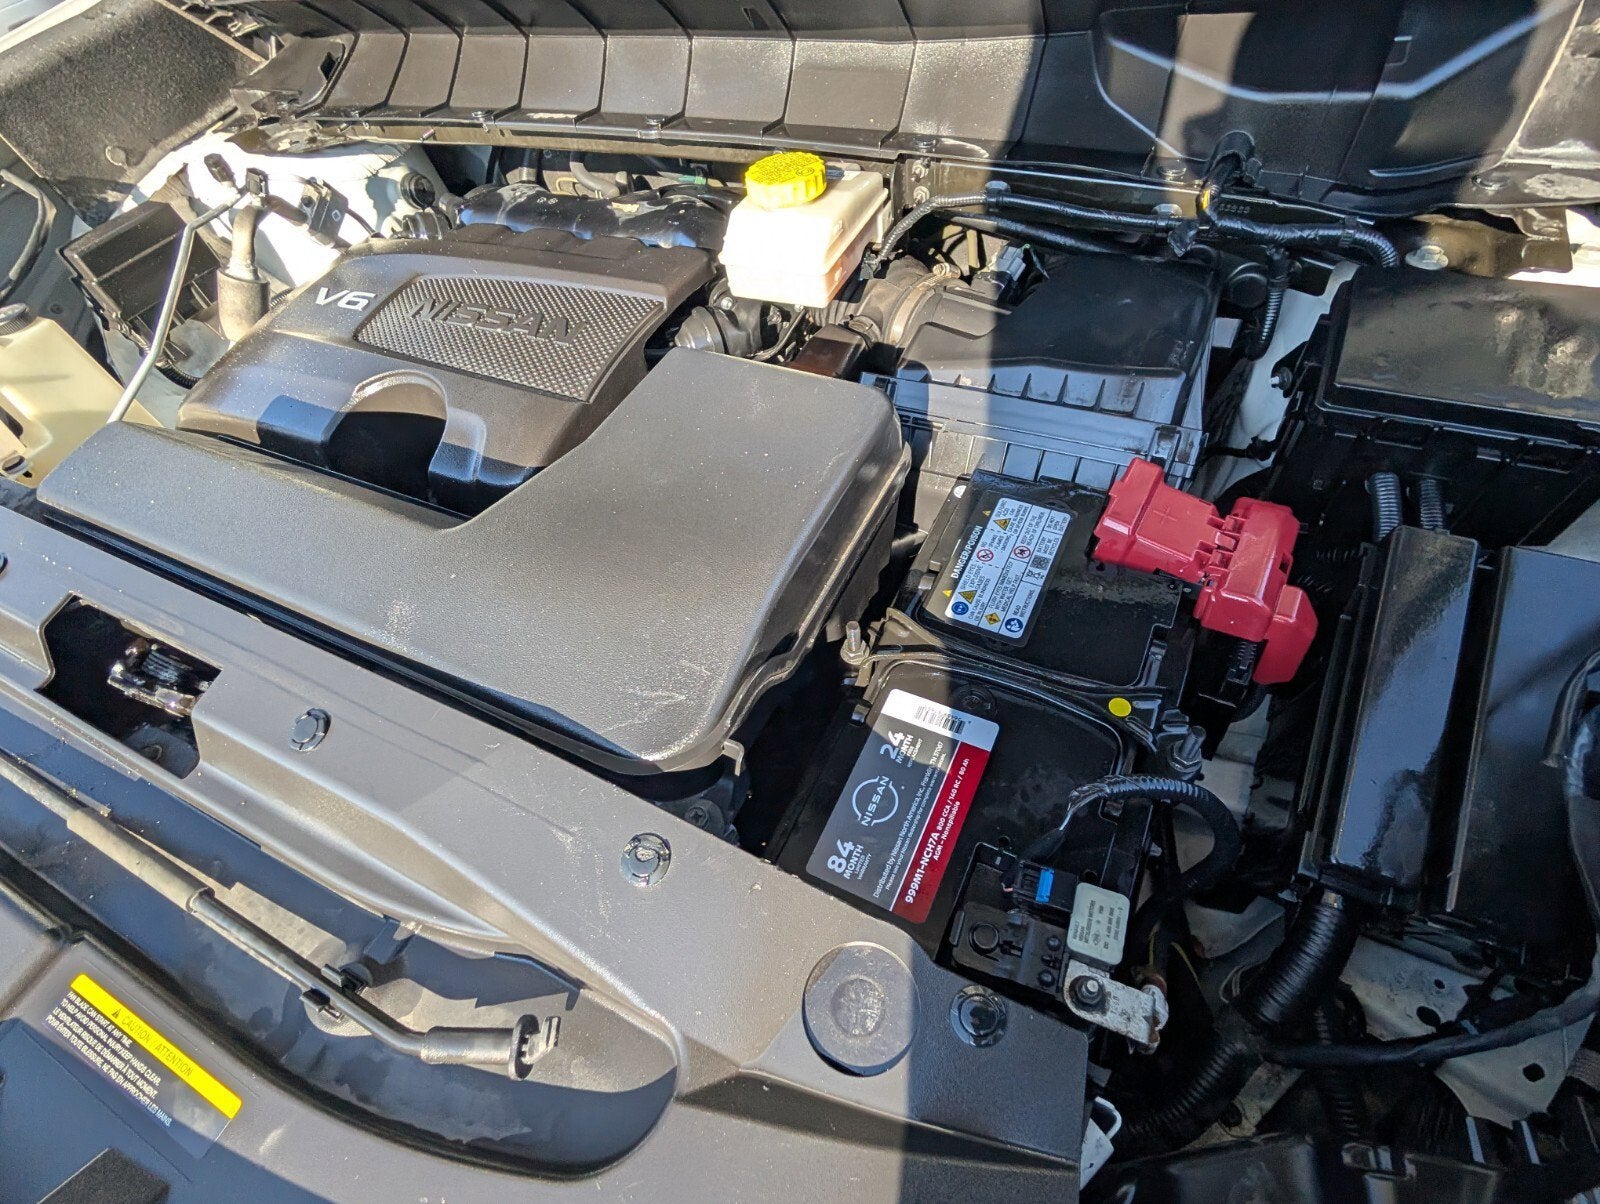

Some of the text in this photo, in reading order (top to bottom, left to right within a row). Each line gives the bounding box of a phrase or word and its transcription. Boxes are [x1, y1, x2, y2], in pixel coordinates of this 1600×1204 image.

[316, 286, 376, 311] V6
[406, 299, 588, 345] NISSAN
[950, 525, 983, 579] DANGER/POISON
[1012, 604, 1022, 617] READ
[879, 728, 906, 760] 24
[895, 734, 914, 764] MONTH
[906, 745, 915, 757] FREE
[932, 741, 944, 758] 37067
[929, 756, 938, 765] TN
[962, 757, 971, 768] Ah
[958, 766, 967, 776] 80
[949, 788, 958, 800] 140
[953, 779, 962, 789] RC
[861, 775, 890, 827] NISSAN
[920, 787, 933, 808] complete
[941, 804, 952, 818] CCA
[898, 818, 911, 837] North
[907, 813, 922, 839] dealership
[932, 844, 944, 861] AGM
[940, 800, 962, 840] Nonspillable
[936, 817, 946, 831] 800
[890, 836, 904, 857] Nissan
[900, 837, 911, 854] Nissan
[825, 837, 856, 875] 84
[843, 844, 864, 880] MONTH
[886, 856, 896, 866] by
[896, 854, 905, 866] your
[857, 853, 873, 881] WARRANTY
[892, 865, 900, 874] see
[904, 831, 941, 904] 999M1-NCH7A
[873, 864, 892, 898] Distributed
[885, 873, 896, 890] Please
[52, 1006, 62, 1017] LE
[66, 990, 79, 1002] FAN
[74, 997, 90, 1012] BLADE
[85, 1006, 99, 1019] CAN
[94, 1013, 110, 1029] START
[105, 1023, 116, 1033] AT
[111, 1027, 123, 1040] ANY
[56, 1011, 85, 1036] VENTILATEUR
[60, 998, 70, 1008] TO
[65, 1002, 80, 1016] HELP
[74, 1010, 90, 1026] AVOID
[86, 1020, 111, 1043] PERSONAL
[118, 1047, 134, 1062] KEEP
[129, 1056, 148, 1074] HANDS
[80, 1030, 98, 1048] RISQUE
[94, 1042, 105, 1053] DE
[121, 1015, 153, 1044] CAUTION
[154, 1042, 195, 1078] ATTENTION
[45, 1014, 61, 1029] POUR
[55, 1021, 74, 1040] ÉVITER
[68, 1034, 85, 1050] TOUTE
[101, 1062, 112, 1074] NE
[107, 1067, 119, 1080] PAS
[114, 1074, 126, 1086] EN
[121, 1079, 151, 1108] APPROCHER
[146, 1101, 159, 1115] LES
[100, 1045, 128, 1072] DÉMARRER
[121, 1063, 131, 1074] À
[124, 1068, 140, 1084] TOUT
